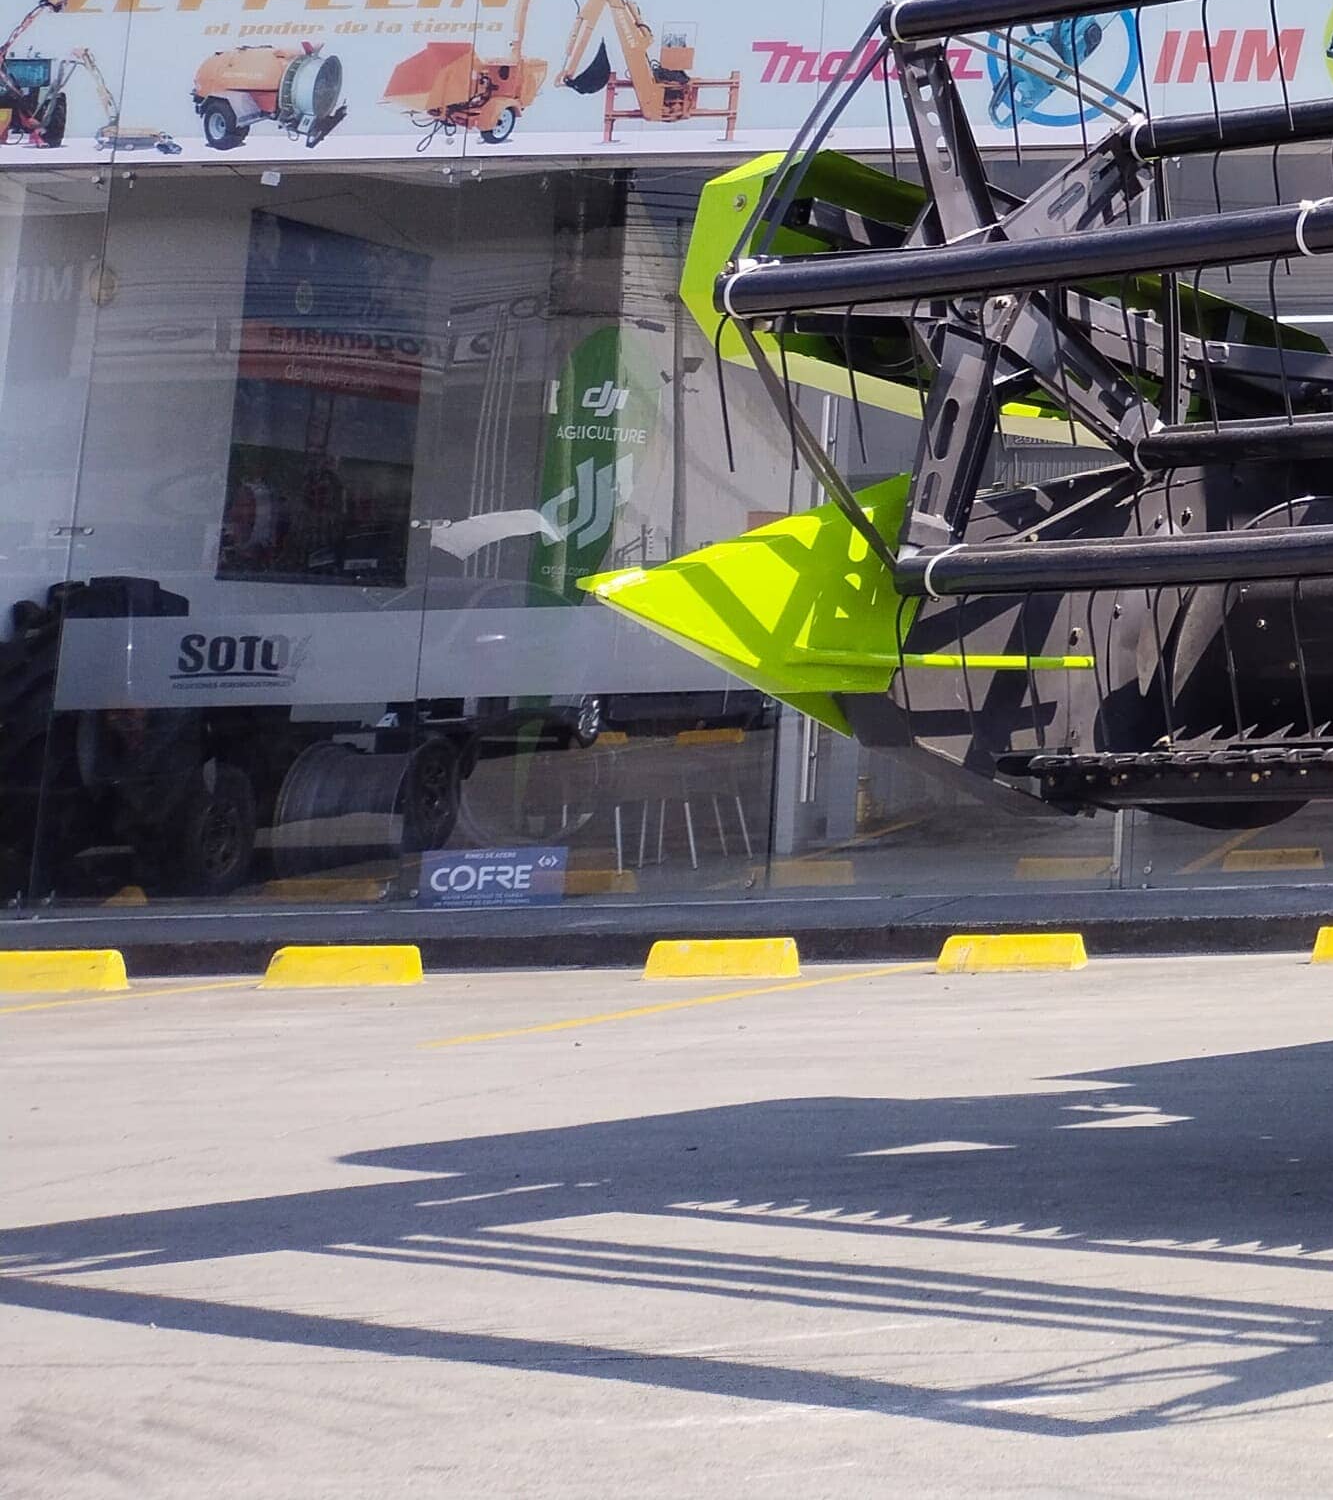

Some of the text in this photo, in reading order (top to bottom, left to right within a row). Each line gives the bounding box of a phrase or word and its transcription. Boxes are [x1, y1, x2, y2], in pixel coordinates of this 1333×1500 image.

[238, 18, 325, 39] poder
[334, 18, 368, 36] de
[411, 16, 504, 35] tierra
[1153, 28, 1306, 84] IHM
[581, 380, 630, 417] dji
[178, 633, 290, 673] SOTO
[430, 864, 534, 892] COFRE
